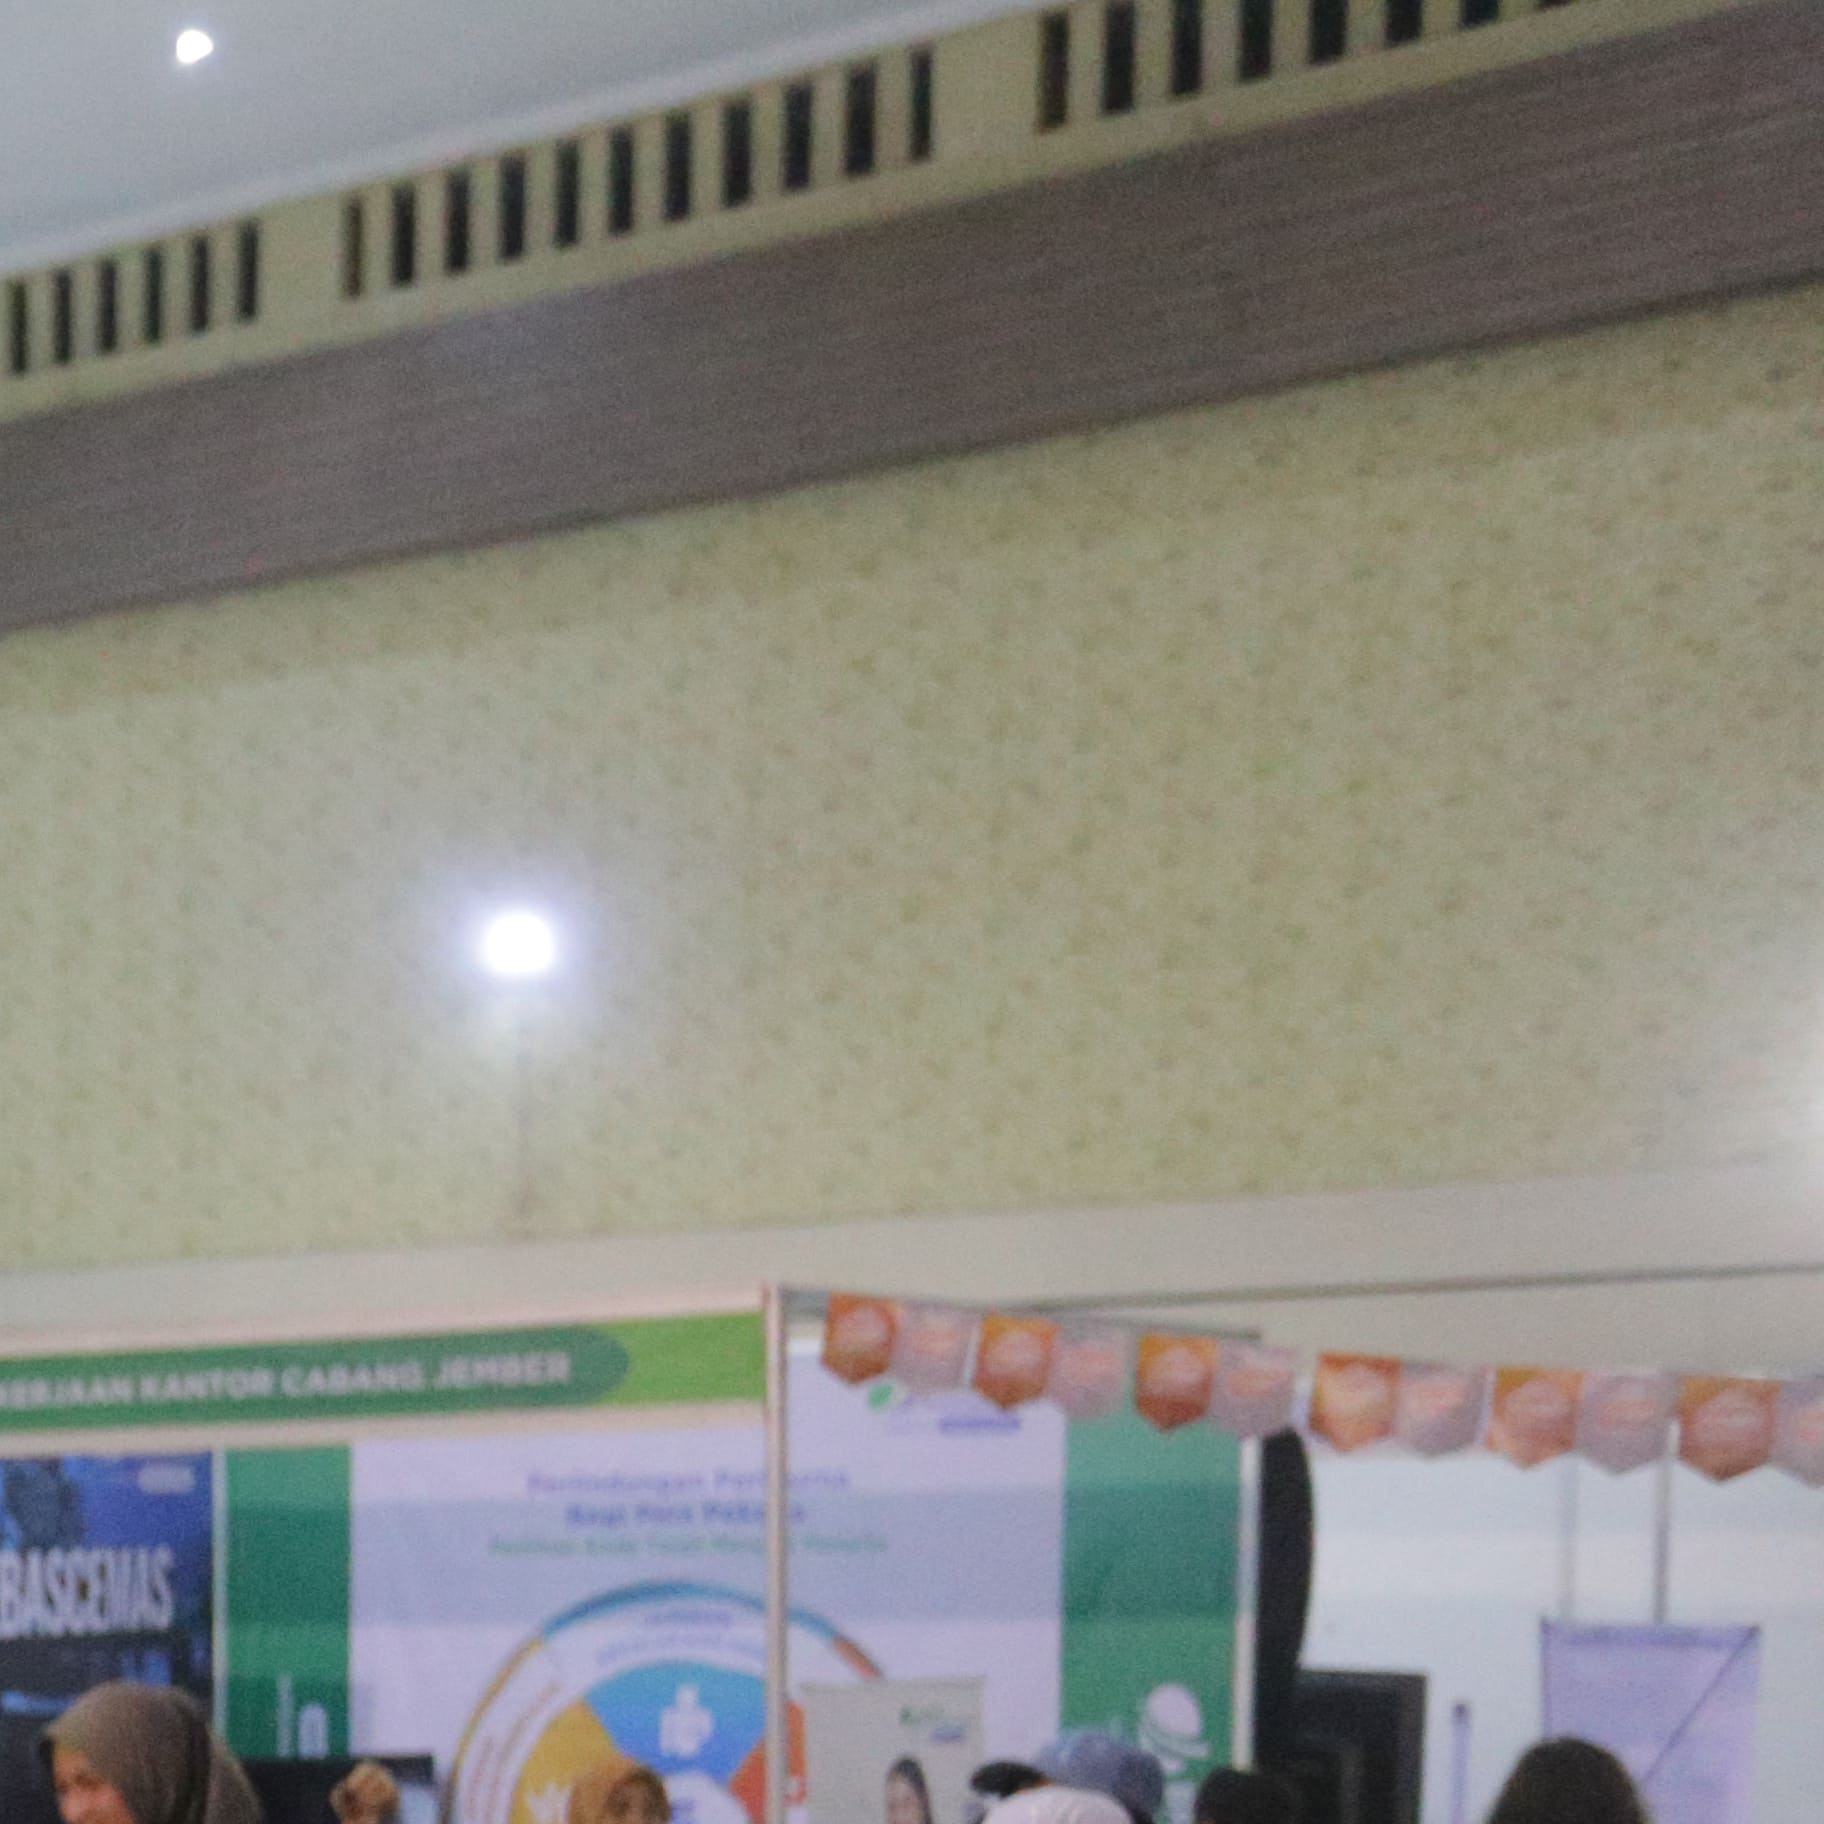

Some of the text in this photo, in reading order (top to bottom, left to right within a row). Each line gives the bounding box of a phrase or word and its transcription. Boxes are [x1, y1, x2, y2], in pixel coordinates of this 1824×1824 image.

[138, 1367, 272, 1402] KANTOR
[280, 1361, 425, 1395] CABANG
[438, 1352, 572, 1387] JEMBER
